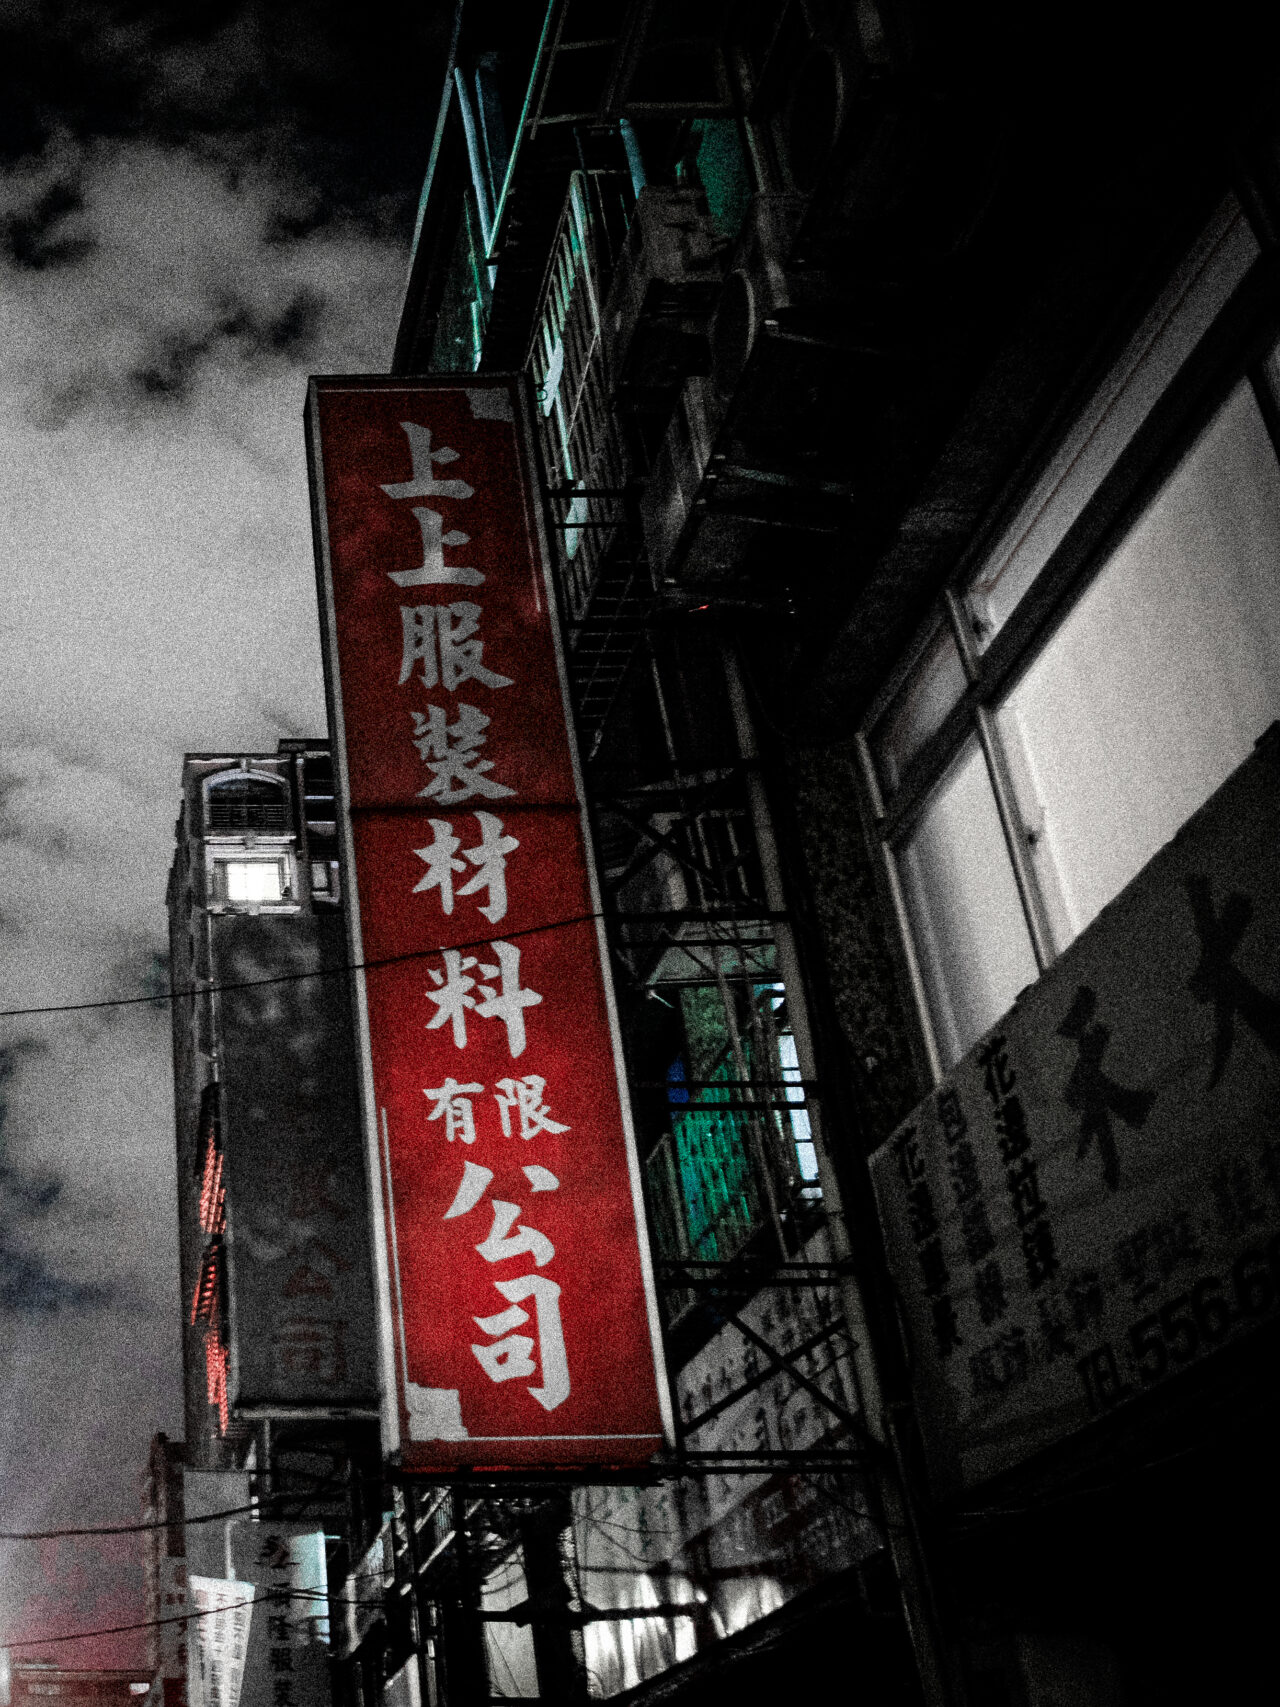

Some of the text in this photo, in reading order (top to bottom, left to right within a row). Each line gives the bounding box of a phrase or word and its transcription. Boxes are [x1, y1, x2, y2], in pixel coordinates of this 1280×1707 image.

[378, 419, 572, 1410] 上上服裝材料有限公司
[1077, 1232, 1280, 1415] TEL:556-6
